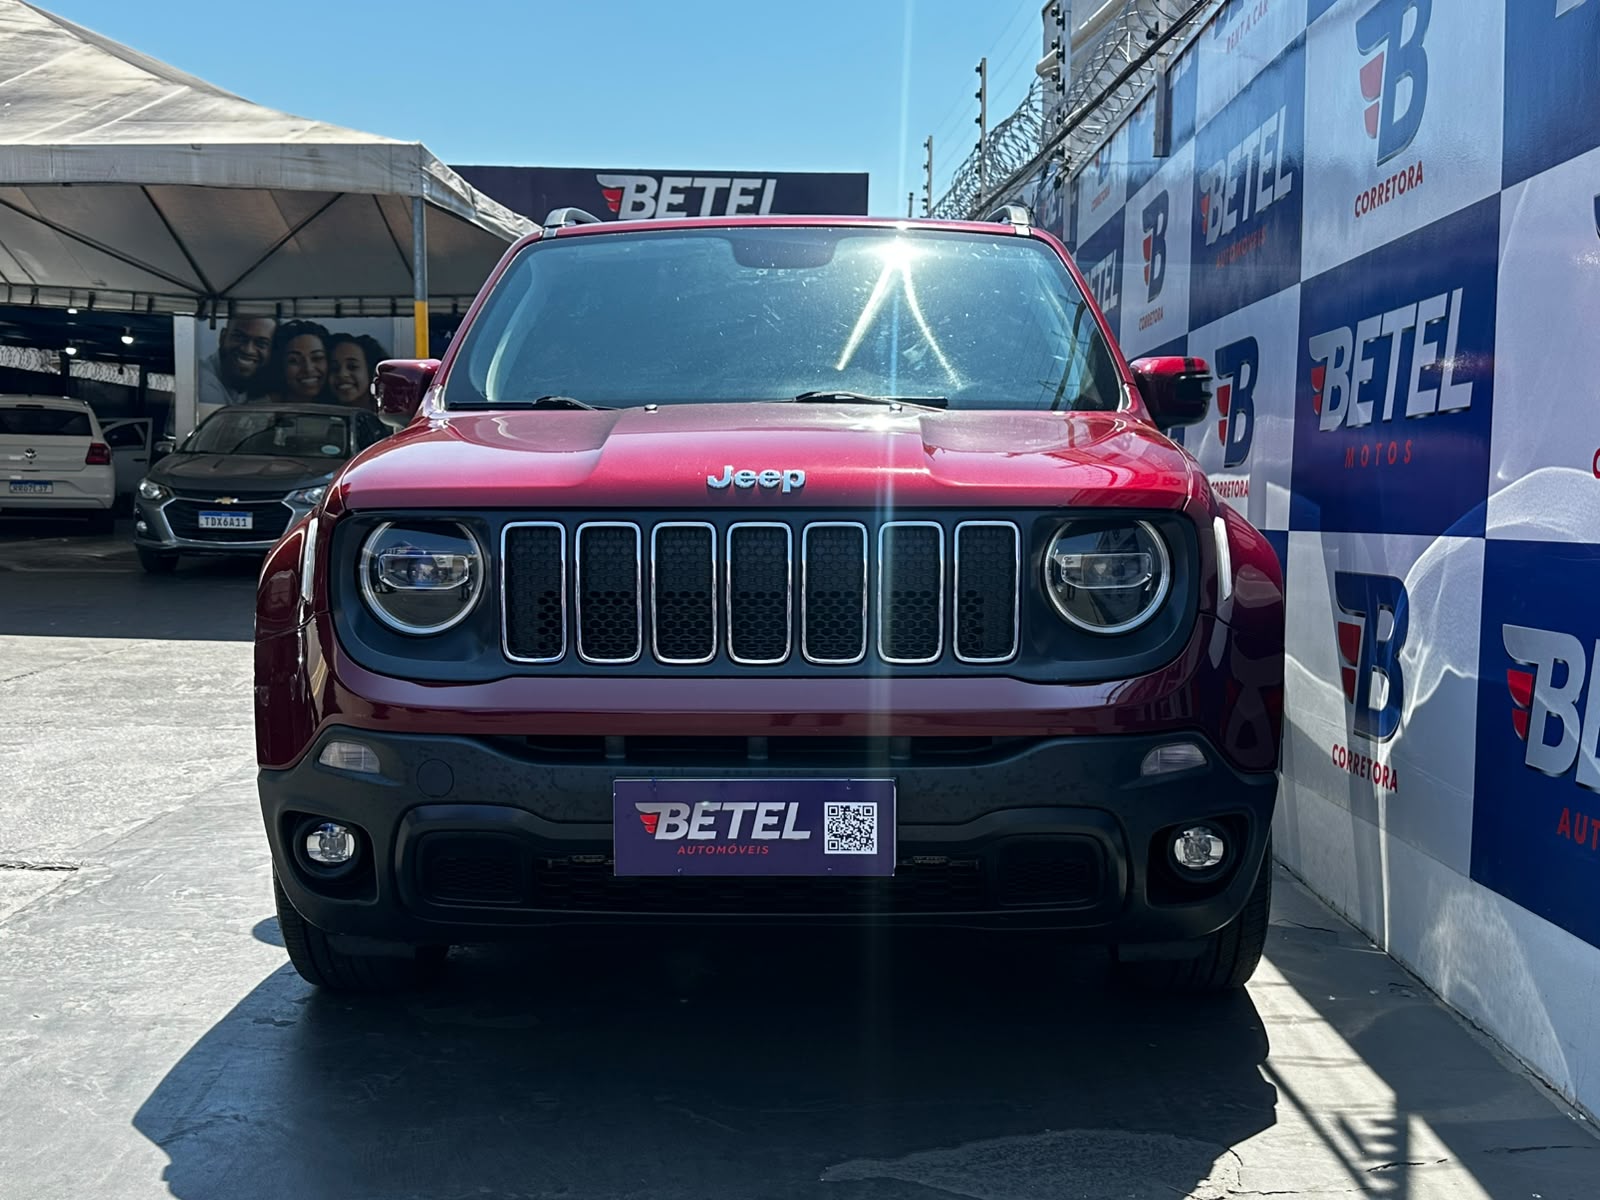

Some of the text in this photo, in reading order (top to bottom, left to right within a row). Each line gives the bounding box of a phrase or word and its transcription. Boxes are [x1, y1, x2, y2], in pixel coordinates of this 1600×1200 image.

[1200, 104, 1293, 246] BETEL
[1354, 160, 1424, 218] CORRETORA
[1084, 249, 1118, 313] ETEL
[1309, 288, 1473, 432] BETEL
[1344, 439, 1413, 469] MOTOS
[707, 465, 806, 493] Jeep
[204, 516, 247, 527] TDX6A11
[1331, 743, 1398, 793] CORRETORA
[635, 802, 811, 840] BETEL
[677, 843, 769, 855] AUTOMÓVEIS
